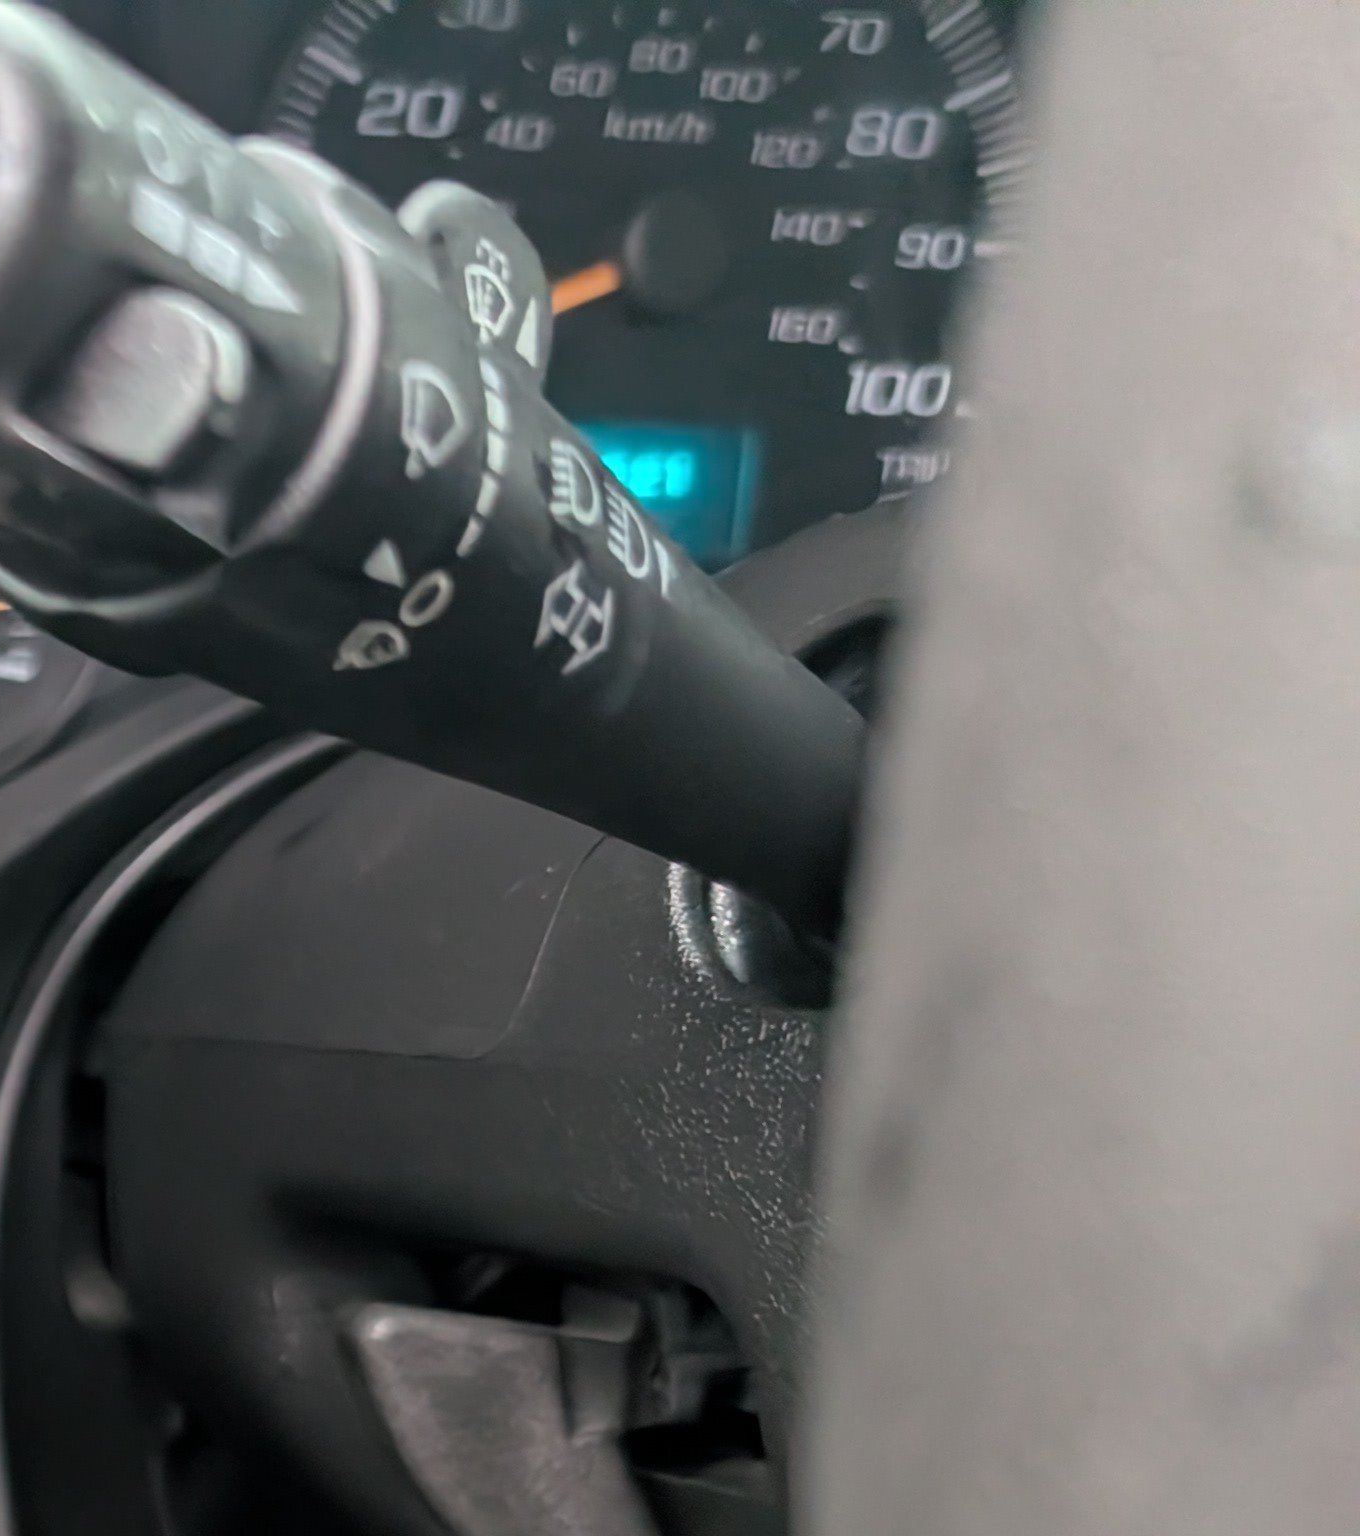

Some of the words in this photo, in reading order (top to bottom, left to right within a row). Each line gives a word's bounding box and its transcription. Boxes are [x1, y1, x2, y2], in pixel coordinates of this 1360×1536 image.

[820, 12, 886, 54] 70
[549, 60, 617, 98] 60
[699, 67, 775, 102] 100
[357, 80, 463, 138] 20
[604, 104, 713, 144] km/h
[751, 132, 820, 168] 120
[846, 108, 941, 159] 80
[771, 208, 843, 246] 140
[894, 224, 966, 270] 90
[768, 307, 839, 344] 160
[845, 363, 951, 416] 100
